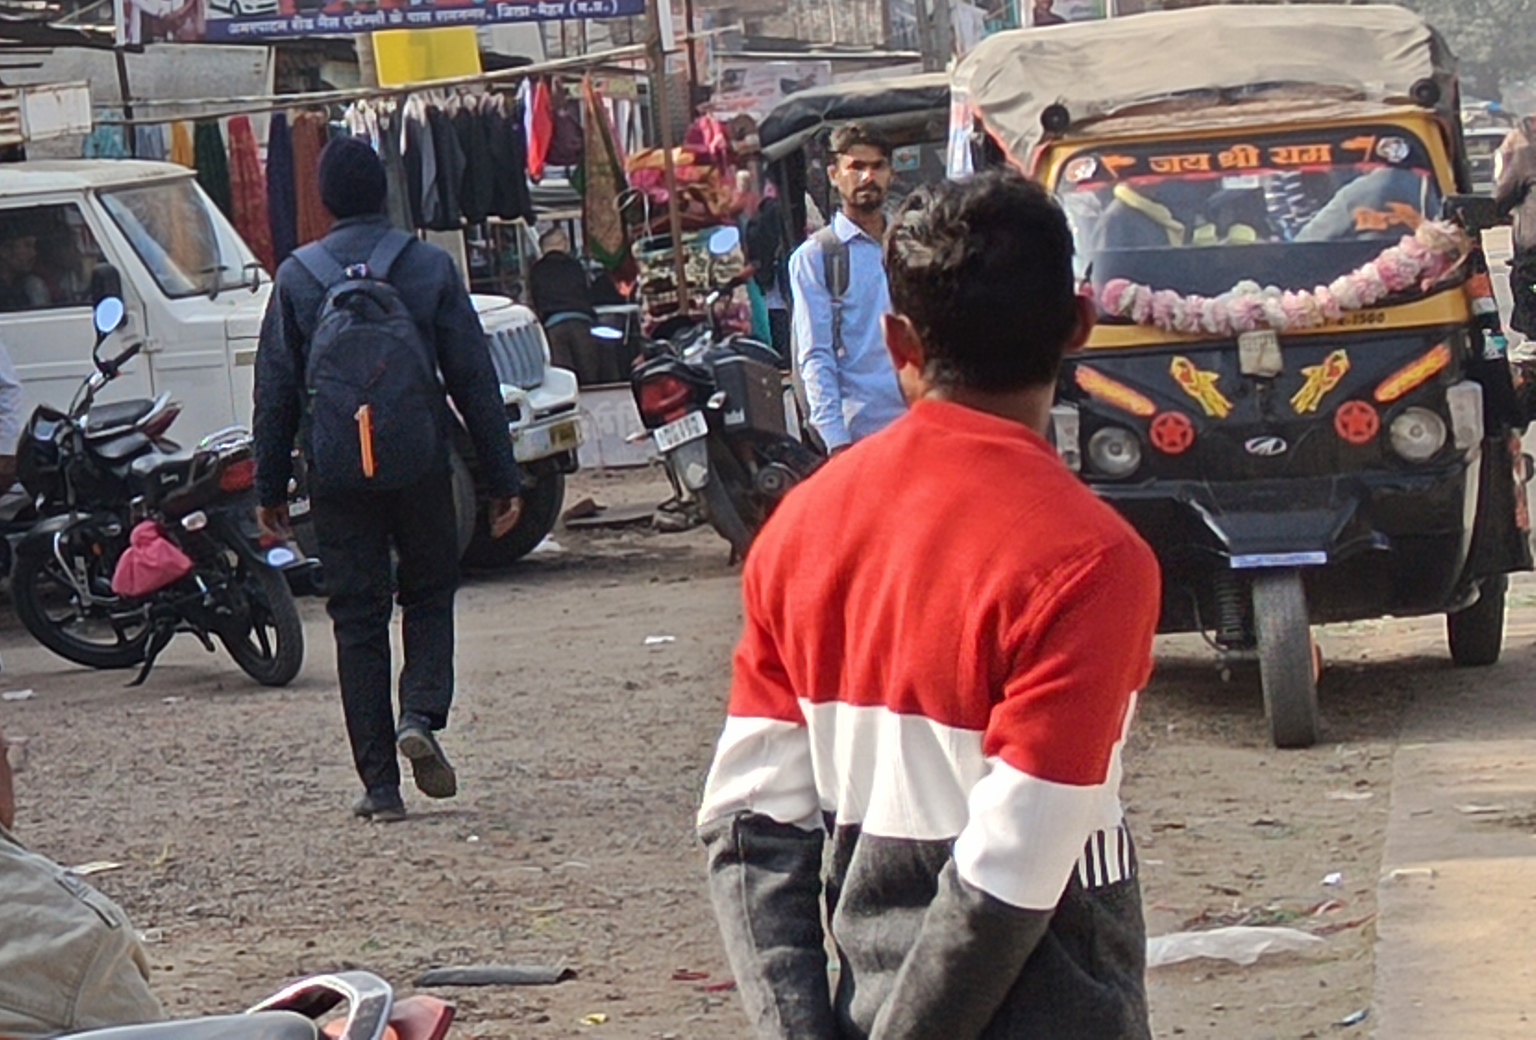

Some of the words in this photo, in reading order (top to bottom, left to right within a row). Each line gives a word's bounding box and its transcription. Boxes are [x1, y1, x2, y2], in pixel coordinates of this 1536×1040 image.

[1148, 153, 1211, 174] जय
[1217, 143, 1261, 170] श्री
[1268, 143, 1333, 166] राम
